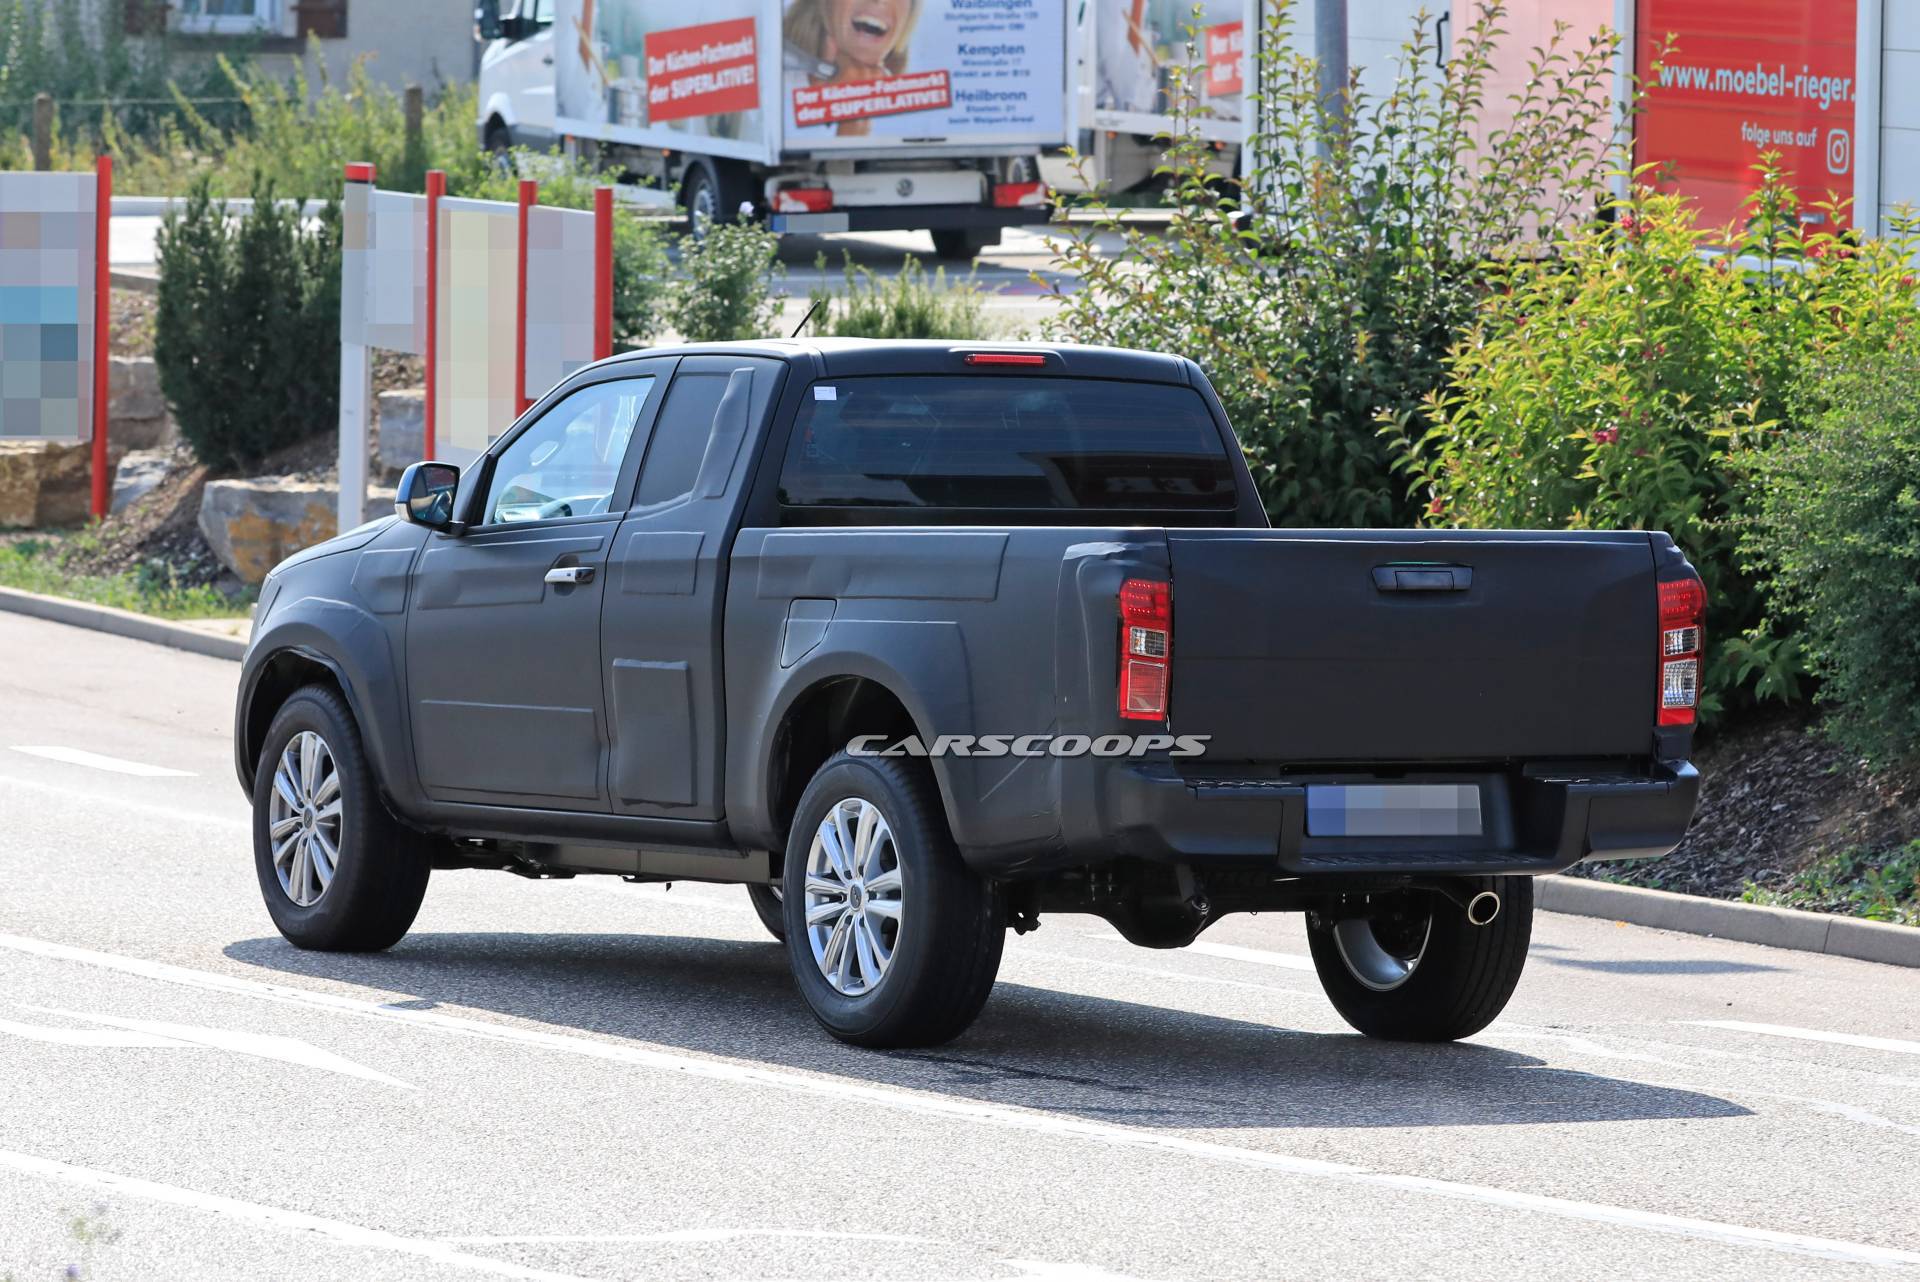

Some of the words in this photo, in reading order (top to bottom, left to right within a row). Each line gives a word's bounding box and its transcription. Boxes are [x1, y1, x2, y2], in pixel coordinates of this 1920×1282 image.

[957, 43, 1026, 57] Kempten
[1659, 62, 1855, 110] www.moebel-rieger.
[795, 90, 819, 105] Der
[955, 89, 1027, 102] Heilbronn
[798, 106, 826, 121] der
[1741, 121, 1770, 148] folge
[1773, 128, 1793, 145] uns
[1796, 127, 1818, 147] auf
